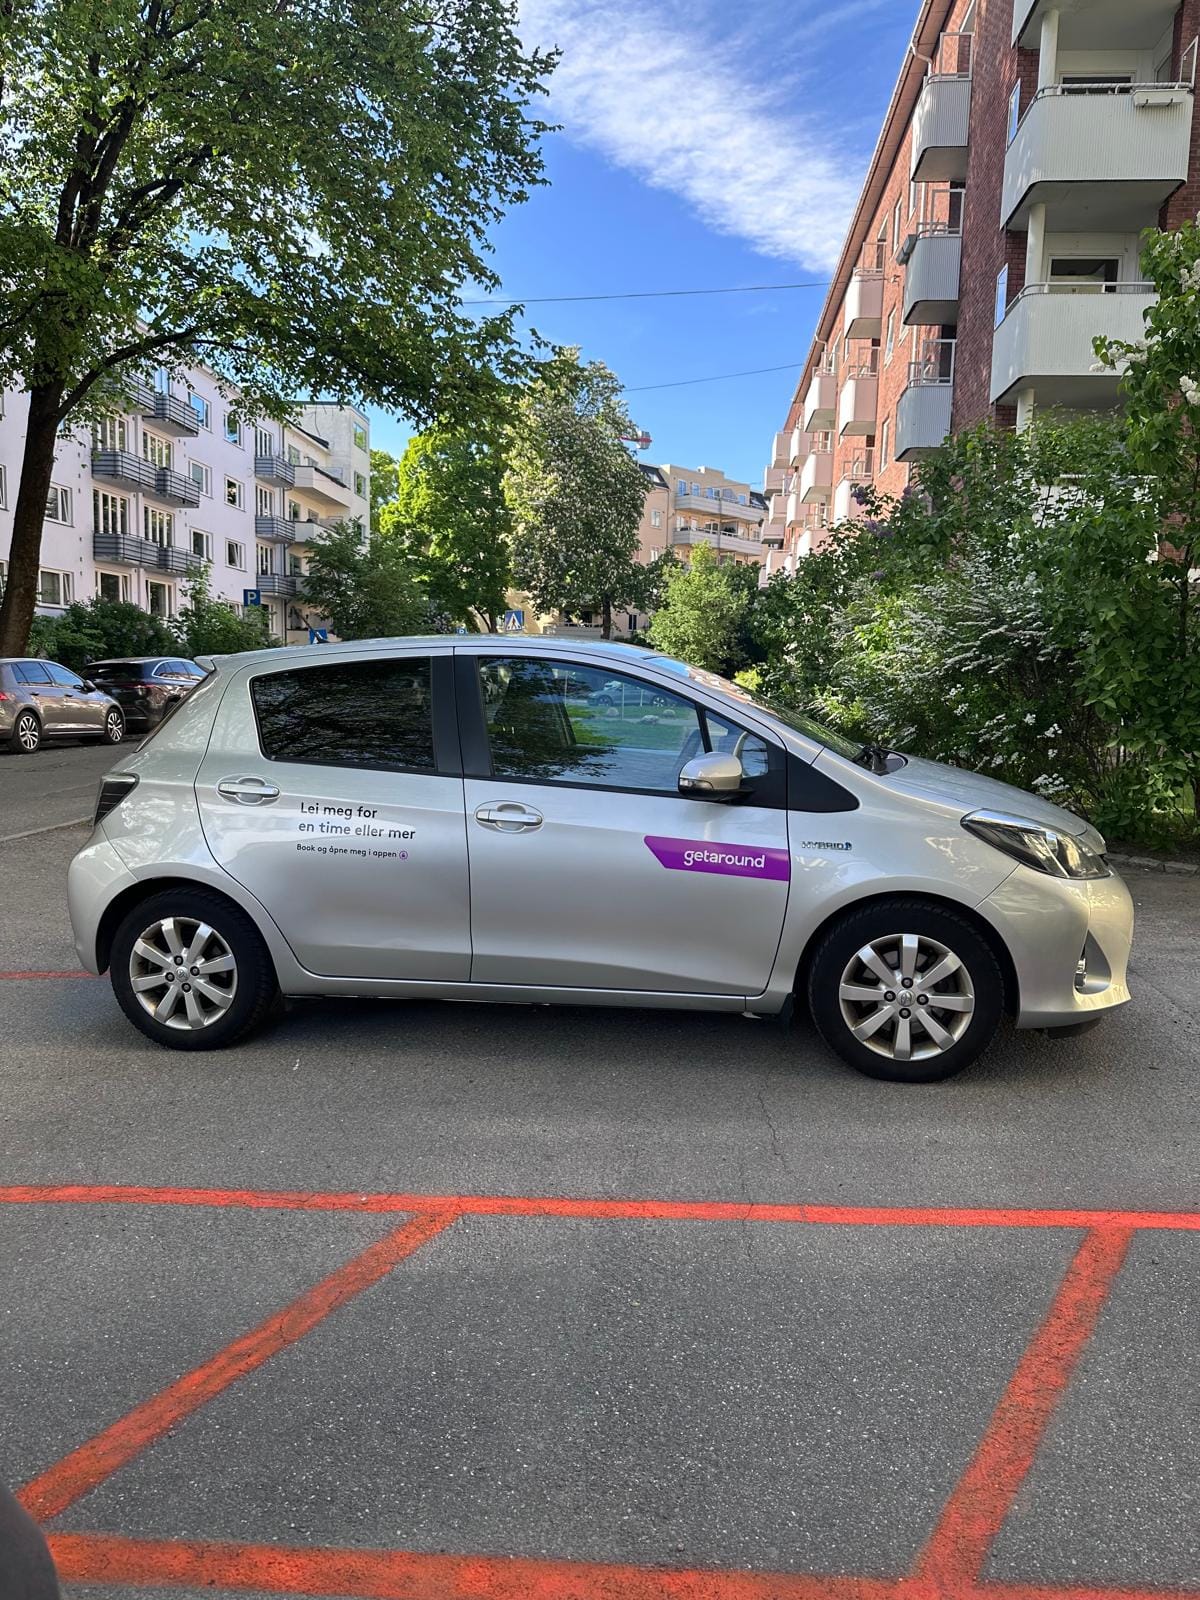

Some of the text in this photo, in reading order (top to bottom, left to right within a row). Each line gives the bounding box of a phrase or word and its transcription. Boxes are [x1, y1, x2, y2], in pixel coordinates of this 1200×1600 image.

[247, 591, 257, 605] P
[300, 802, 378, 820] Lei meg for
[298, 821, 416, 840] en time eller mer
[296, 843, 316, 852] Book
[317, 846, 327, 854] og
[329, 845, 348, 854] åpne
[350, 849, 367, 857] meg
[373, 850, 397, 859] appen
[683, 849, 766, 868] getaround
